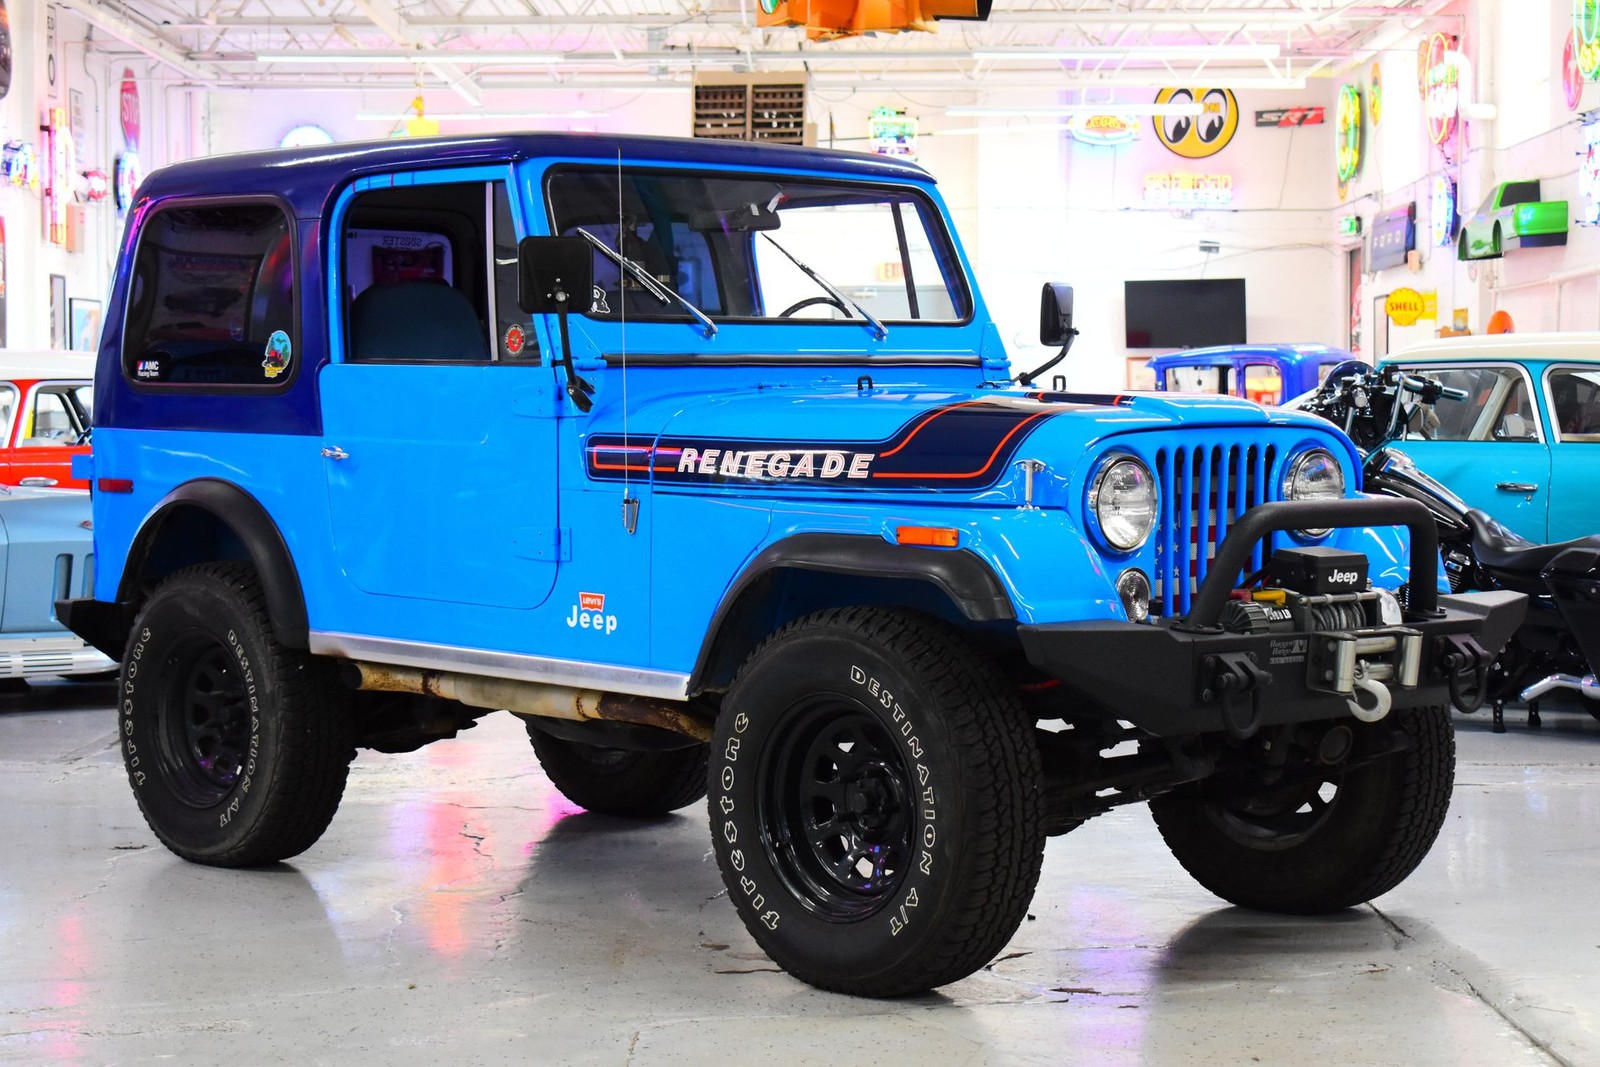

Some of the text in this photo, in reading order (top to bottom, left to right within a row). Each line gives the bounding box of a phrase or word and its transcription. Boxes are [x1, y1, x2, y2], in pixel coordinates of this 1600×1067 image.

[1257, 110, 1323, 124] SRT
[1389, 302, 1419, 311] SHELL
[144, 361, 159, 371] AMC
[678, 447, 875, 479] RENEGADE
[1328, 569, 1358, 585] Jeep
[566, 605, 617, 635] Jeep
[219, 630, 259, 827] DESTINATION A/T
[850, 665, 936, 936] DESTINATION A/T
